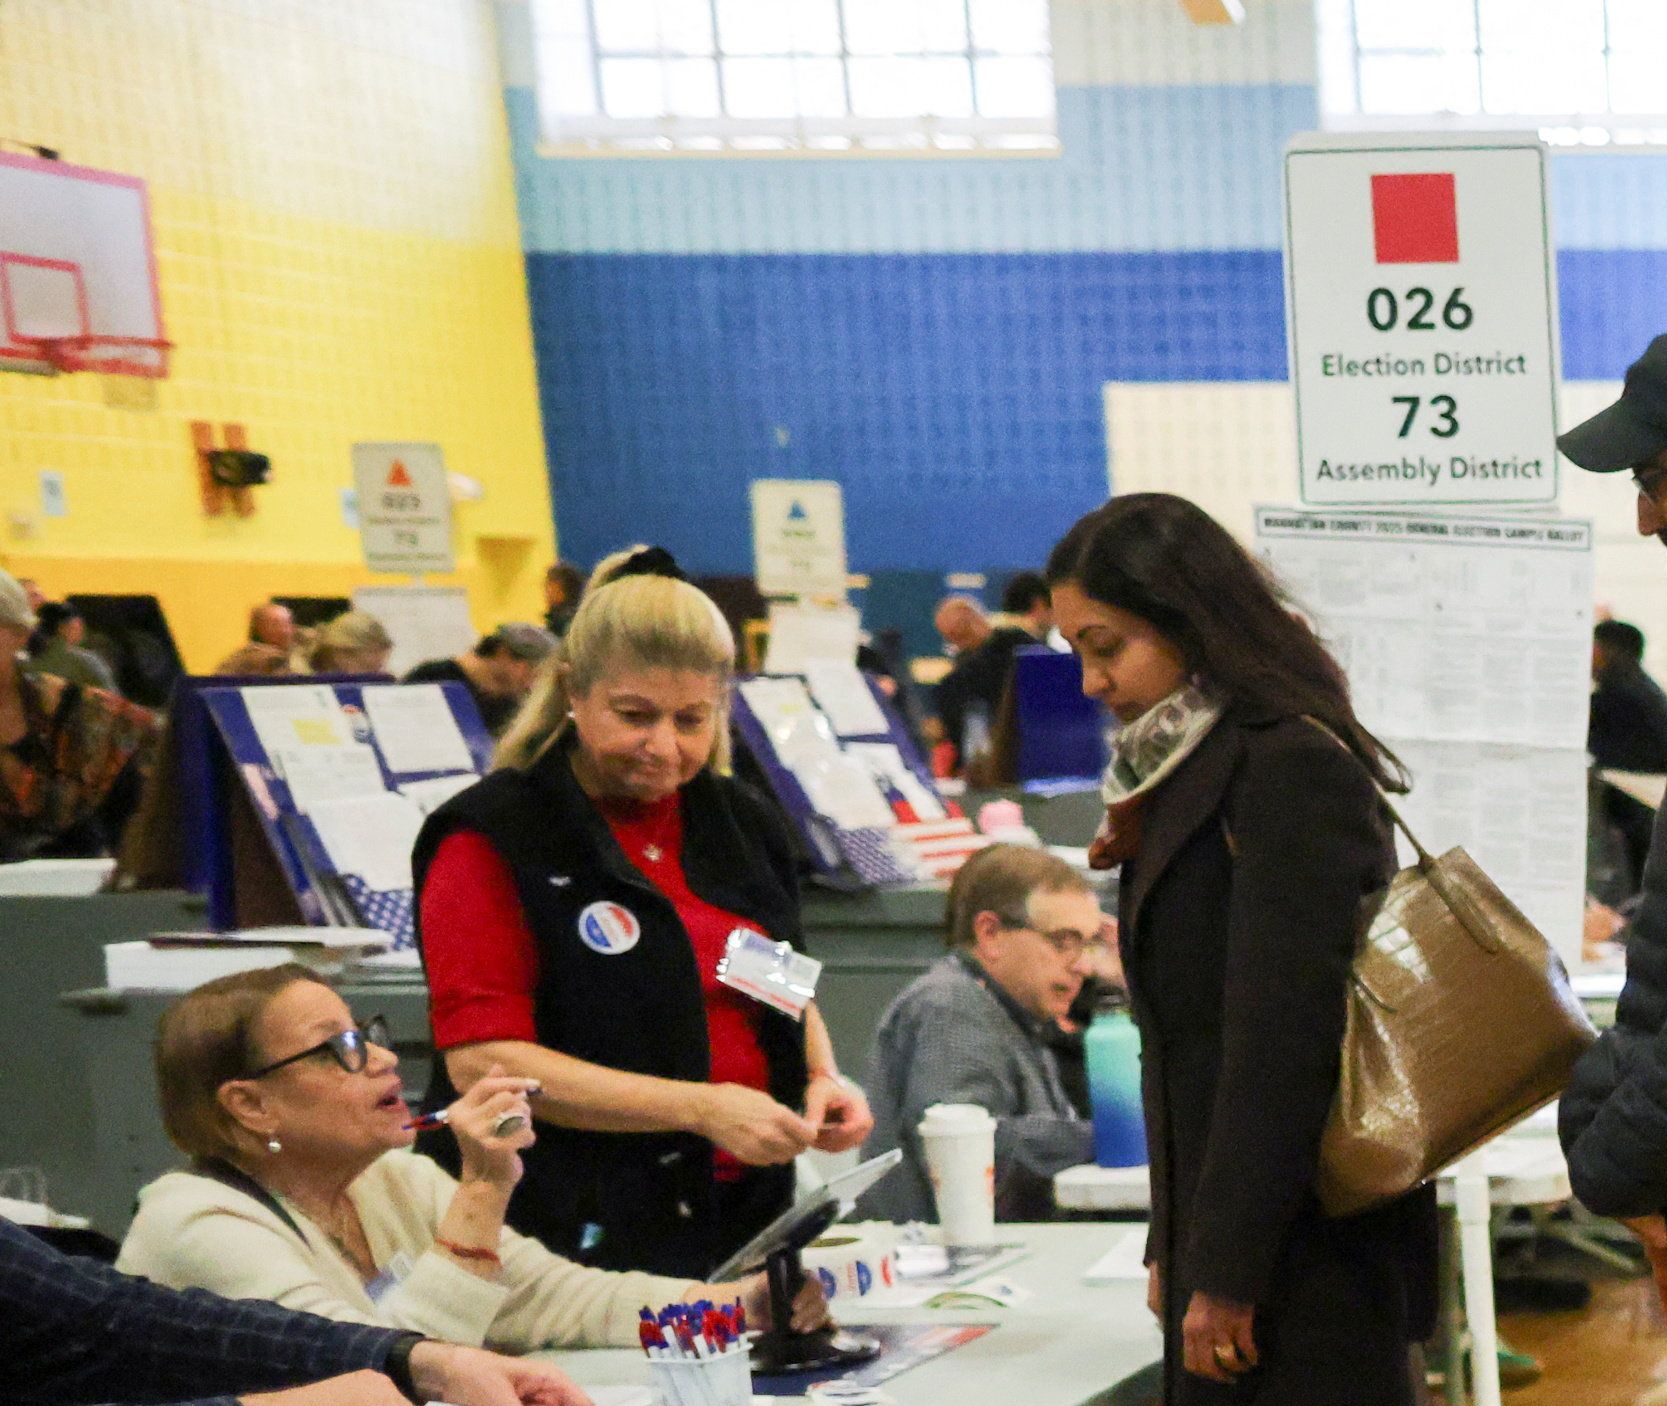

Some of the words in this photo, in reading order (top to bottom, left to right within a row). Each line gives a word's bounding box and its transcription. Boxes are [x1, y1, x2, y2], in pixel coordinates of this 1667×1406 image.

[1366, 286, 1474, 332] 026
[1321, 353, 1426, 377] Election
[1433, 351, 1527, 376] District
[1391, 394, 1460, 439] 73
[1316, 457, 1441, 487] Assembly
[1449, 456, 1543, 480] District
